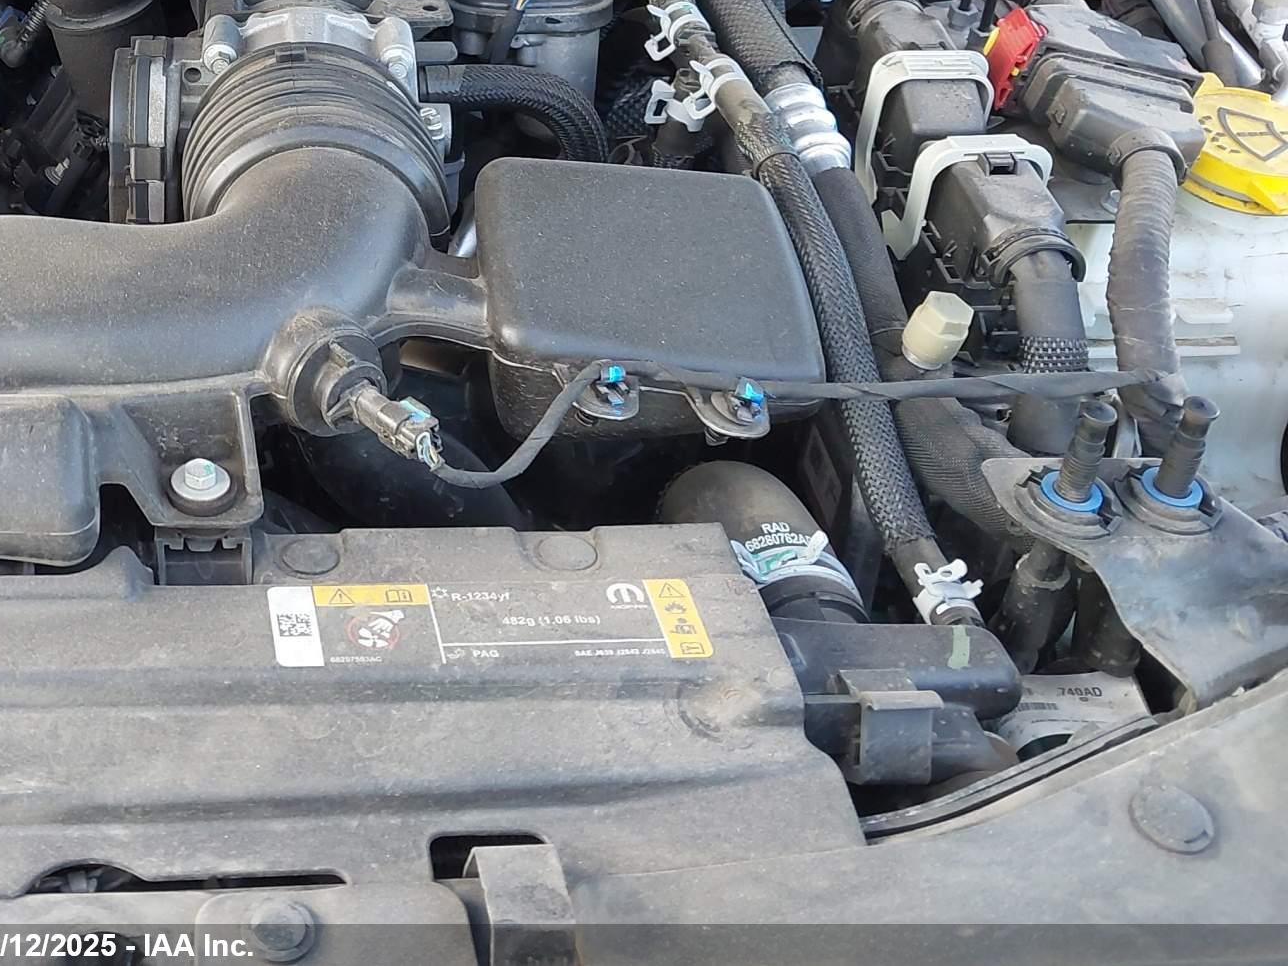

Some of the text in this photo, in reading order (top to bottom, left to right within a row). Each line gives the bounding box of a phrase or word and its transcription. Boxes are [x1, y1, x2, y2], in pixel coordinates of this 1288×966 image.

[761, 522, 790, 534] RAD
[450, 590, 511, 602] R-1234yf
[501, 616, 536, 627] 482g
[574, 614, 602, 626] lbs)
[472, 649, 500, 659] PAG
